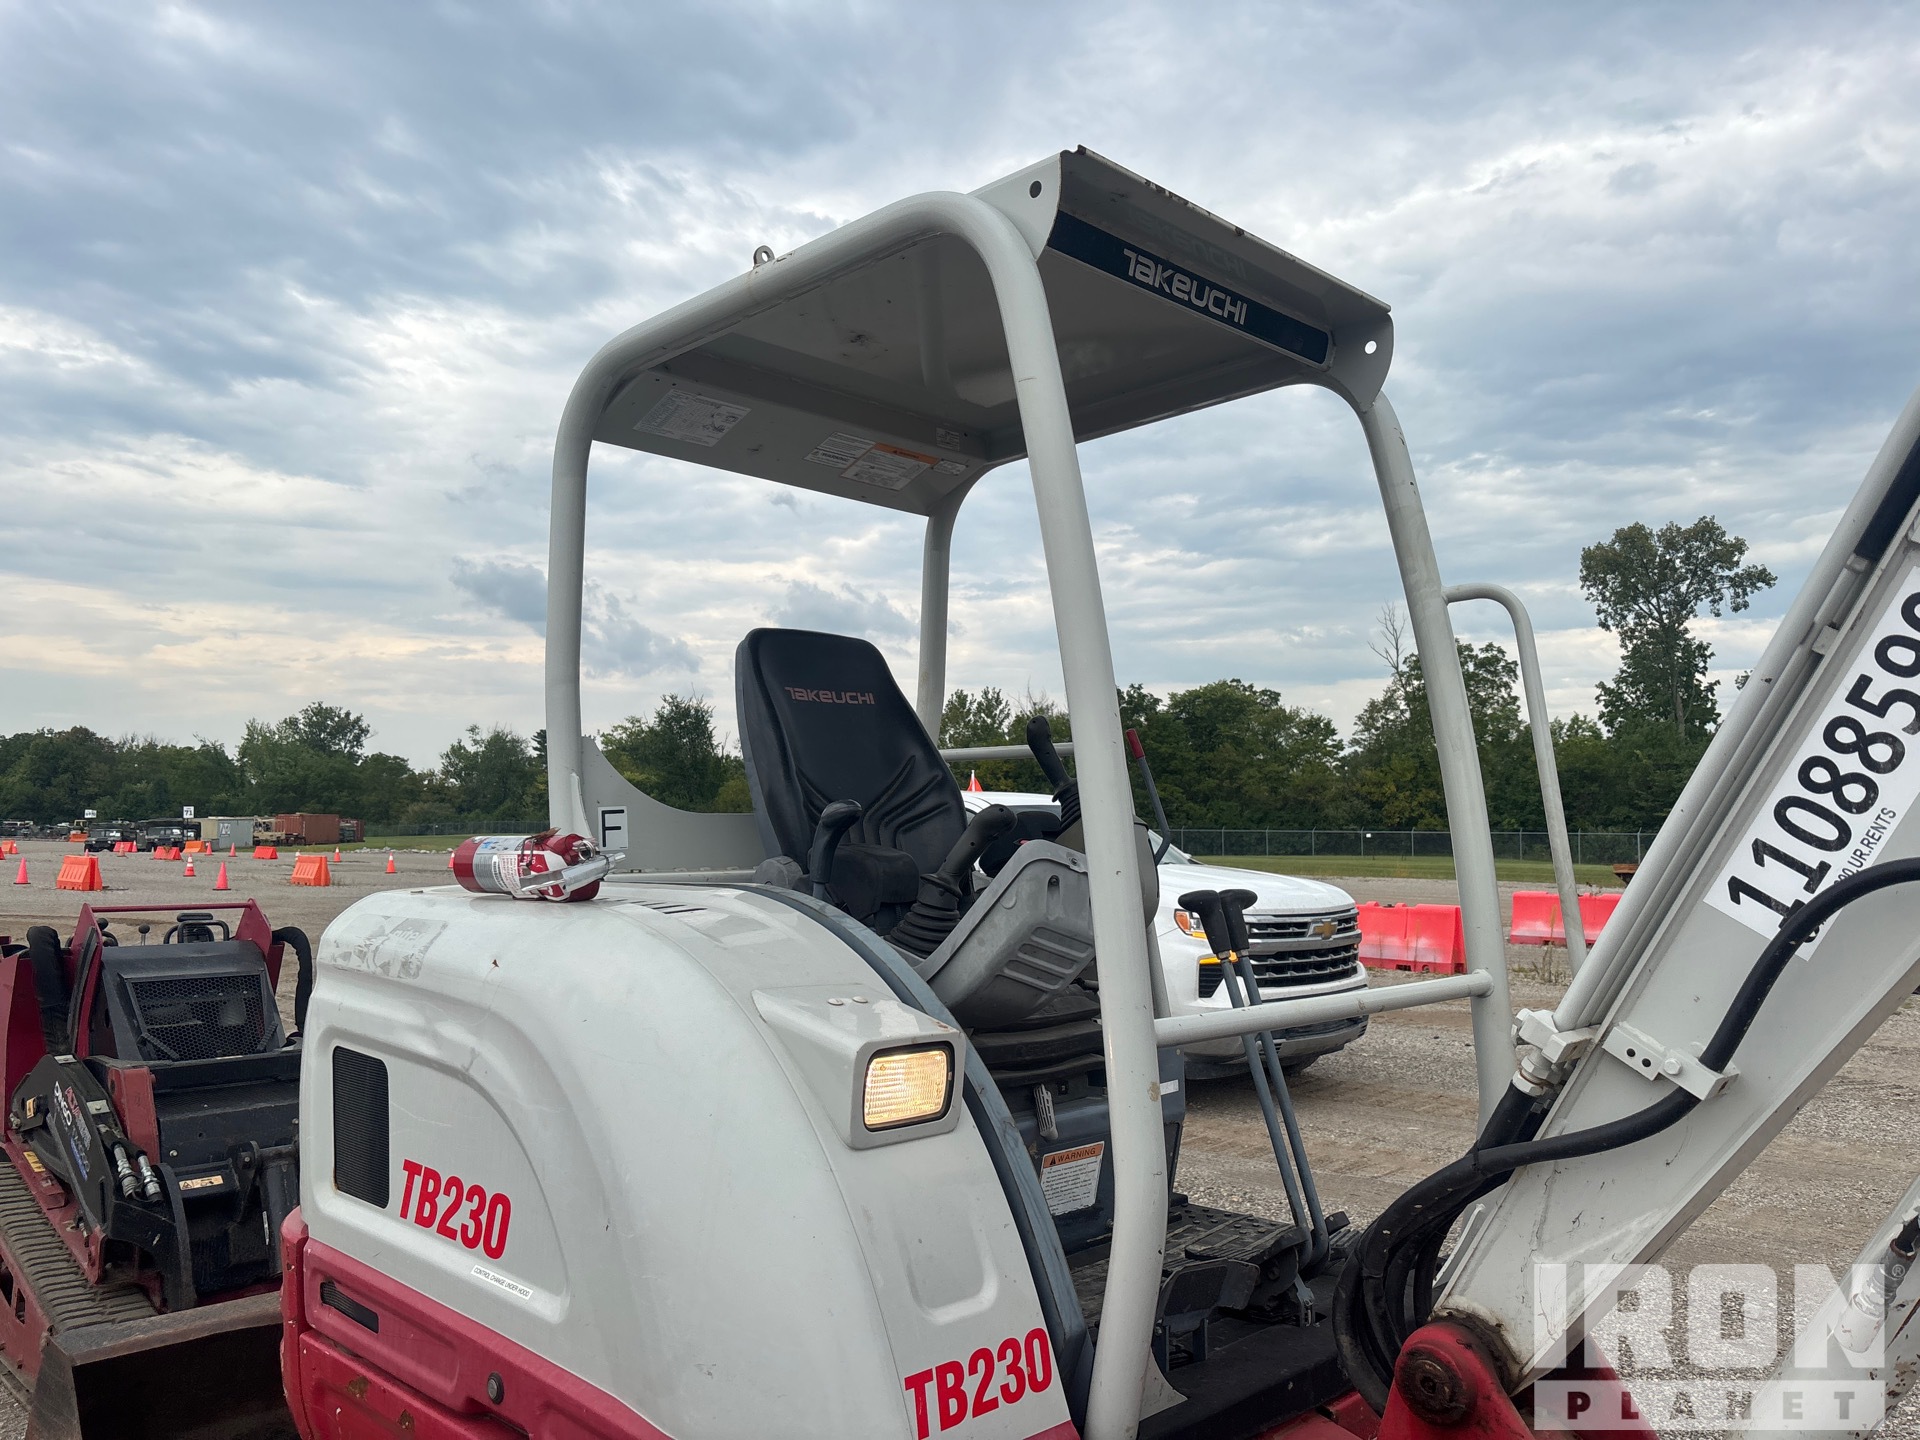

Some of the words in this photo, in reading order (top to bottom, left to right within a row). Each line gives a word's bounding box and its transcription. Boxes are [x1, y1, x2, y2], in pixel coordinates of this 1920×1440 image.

[1727, 592, 1920, 929] 1108859
[601, 809, 625, 847] F
[1058, 1148, 1096, 1162] WARNING
[400, 1159, 511, 1260] TB230
[473, 1267, 490, 1280] CONTROL
[490, 1275, 505, 1287] CHANGE
[505, 1282, 518, 1292] UNDER
[518, 1288, 530, 1297] HOOD
[904, 1327, 1052, 1440] TB230
